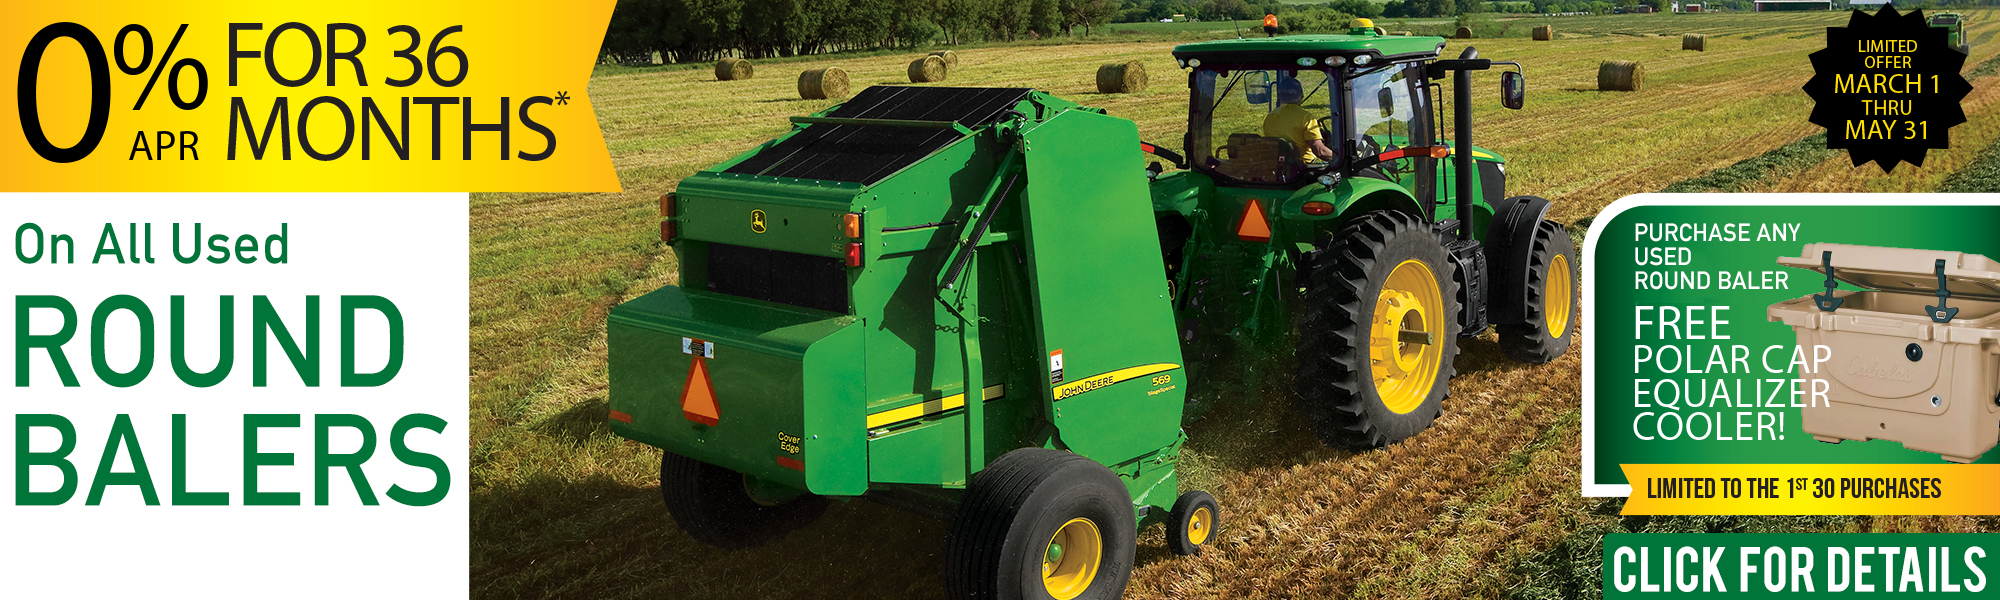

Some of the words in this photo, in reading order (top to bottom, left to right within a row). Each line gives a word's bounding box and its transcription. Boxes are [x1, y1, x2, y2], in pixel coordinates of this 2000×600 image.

[1152, 374, 1171, 386] 569
[1058, 382, 1084, 400] JOHN
[1084, 375, 1114, 391] DEERE
[778, 431, 801, 444] Cover
[780, 442, 800, 454] Edge
